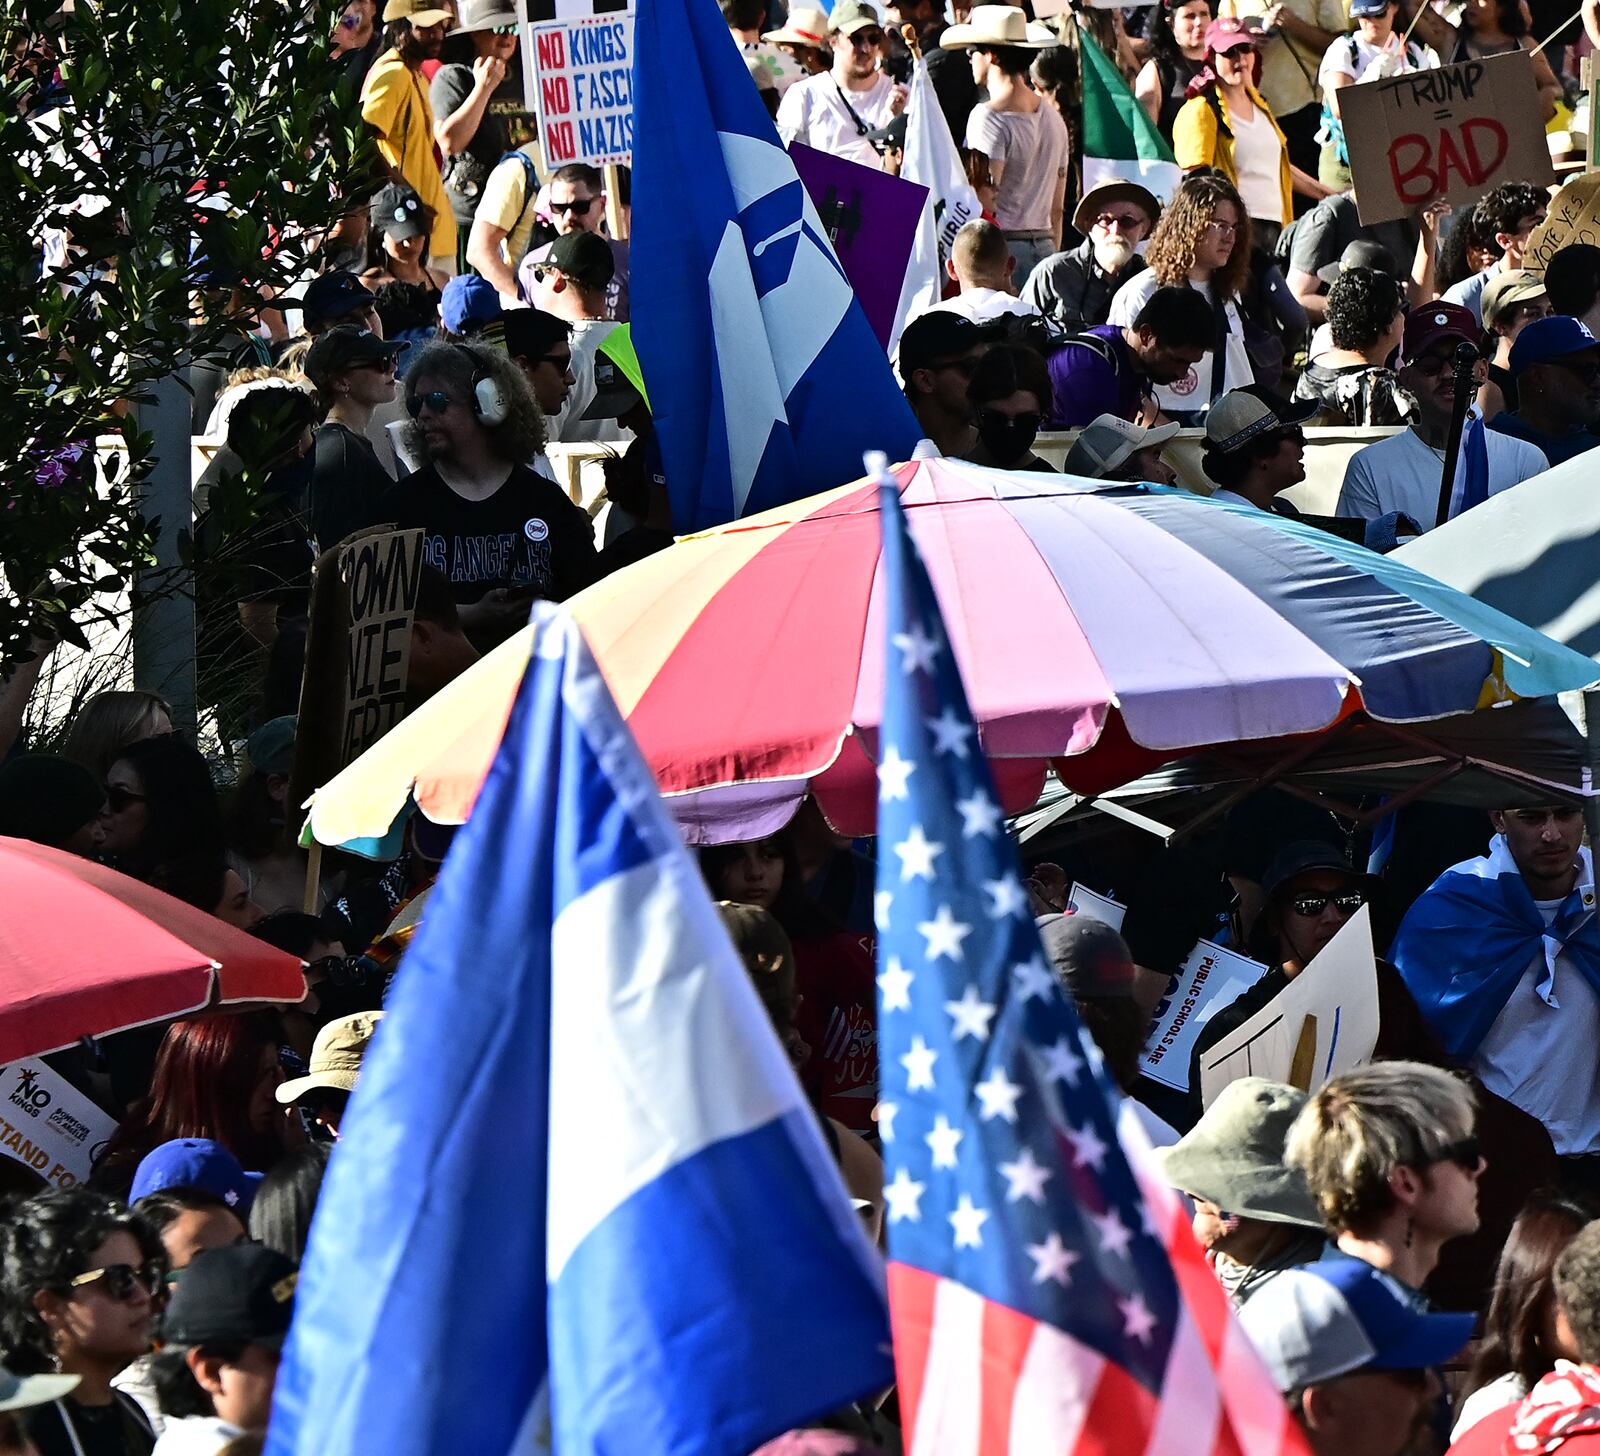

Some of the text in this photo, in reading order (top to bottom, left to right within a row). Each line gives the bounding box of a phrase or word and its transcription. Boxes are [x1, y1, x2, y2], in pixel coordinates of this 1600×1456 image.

[537, 23, 627, 71] NO KINGS
[541, 67, 633, 116] NO FASCI
[1377, 63, 1484, 109] TRUMP
[546, 120, 576, 162] NO
[1386, 117, 1509, 205] BAD
[1523, 194, 1585, 272] VOTE YES
[450, 532, 554, 585] ANGELES
[1192, 954, 1216, 998] PUBLIC
[1160, 996, 1197, 1046] SCHOOLS
[1146, 1044, 1171, 1066] ARE
[8, 1092, 41, 1119] KINGS
[15, 1079, 52, 1109] NO
[49, 1112, 89, 1143] LOS ANGELES
[56, 1107, 92, 1136] DOWNTOWN
